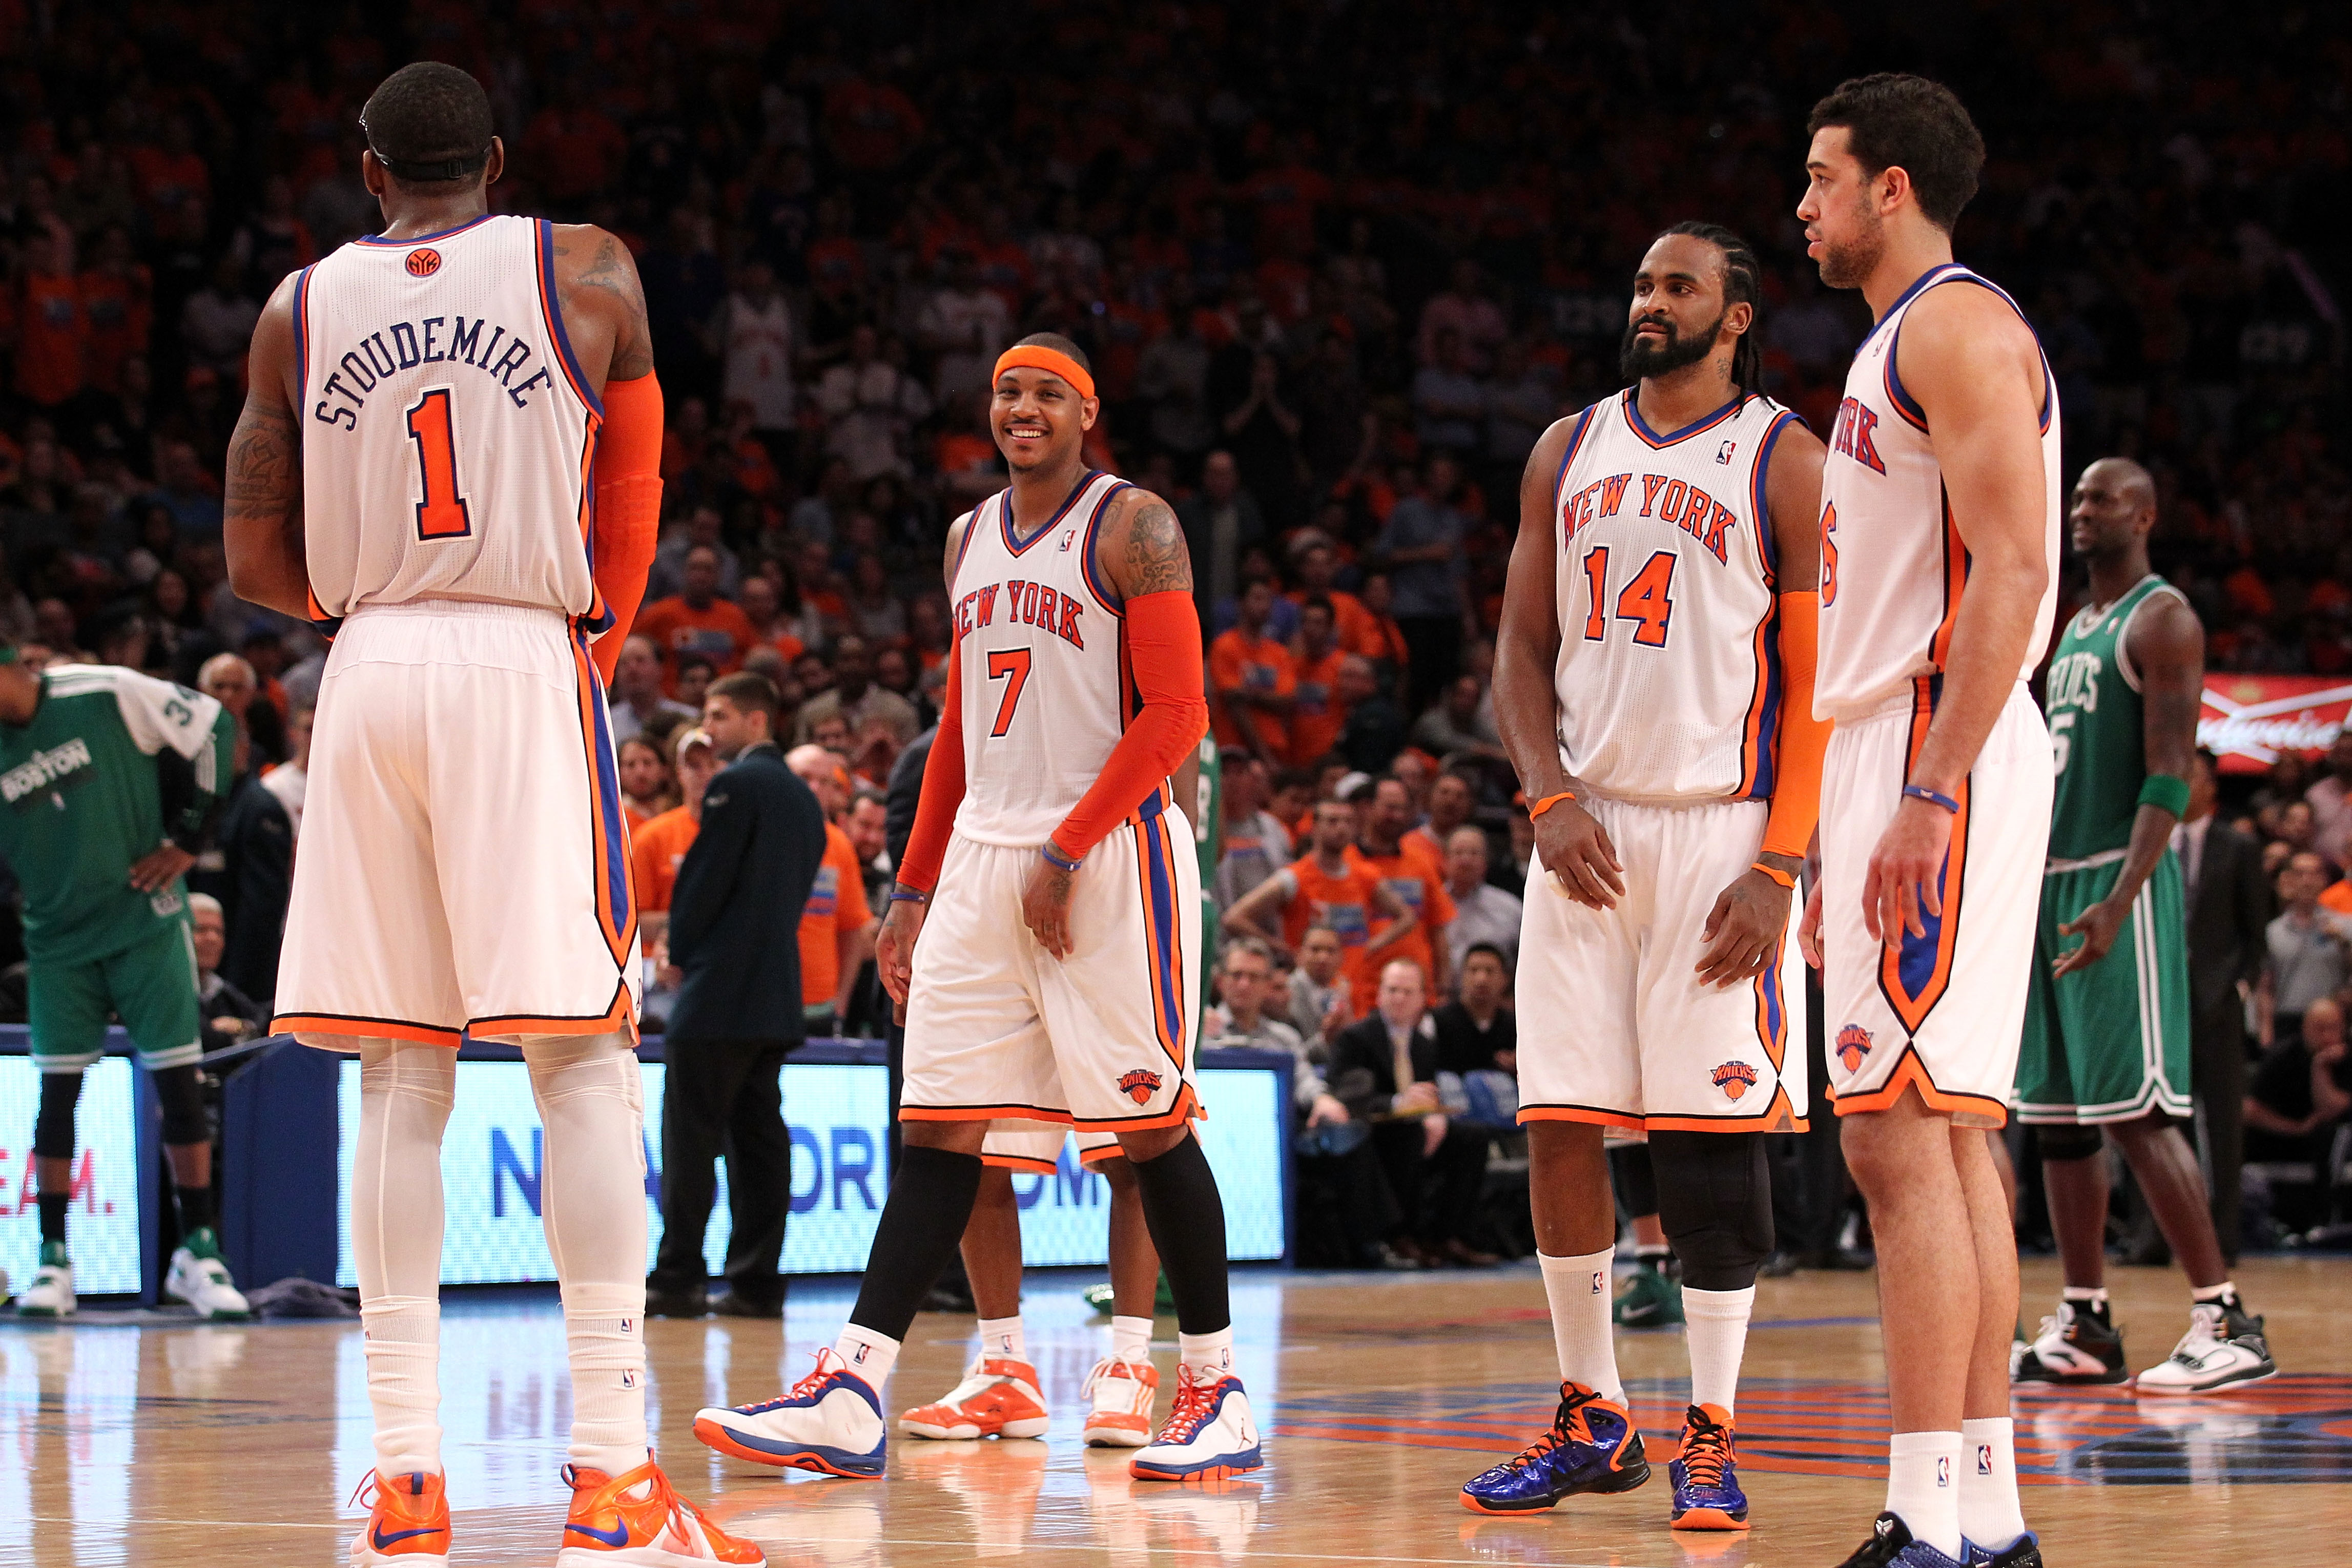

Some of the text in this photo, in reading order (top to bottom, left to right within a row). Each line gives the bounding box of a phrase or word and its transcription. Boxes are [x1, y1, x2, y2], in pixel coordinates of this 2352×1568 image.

[316, 316, 552, 431] STOUDEMIRE
[407, 388, 472, 542] 1
[1563, 473, 1737, 567] NEW YORK
[1007, 580, 1084, 652] YORK
[1583, 546, 1677, 648] 14
[987, 647, 1031, 738] 7
[2050, 712, 2074, 776] 5
[1119, 1071, 1162, 1090] KNICKS
[1712, 1064, 1758, 1083] KNICKS
